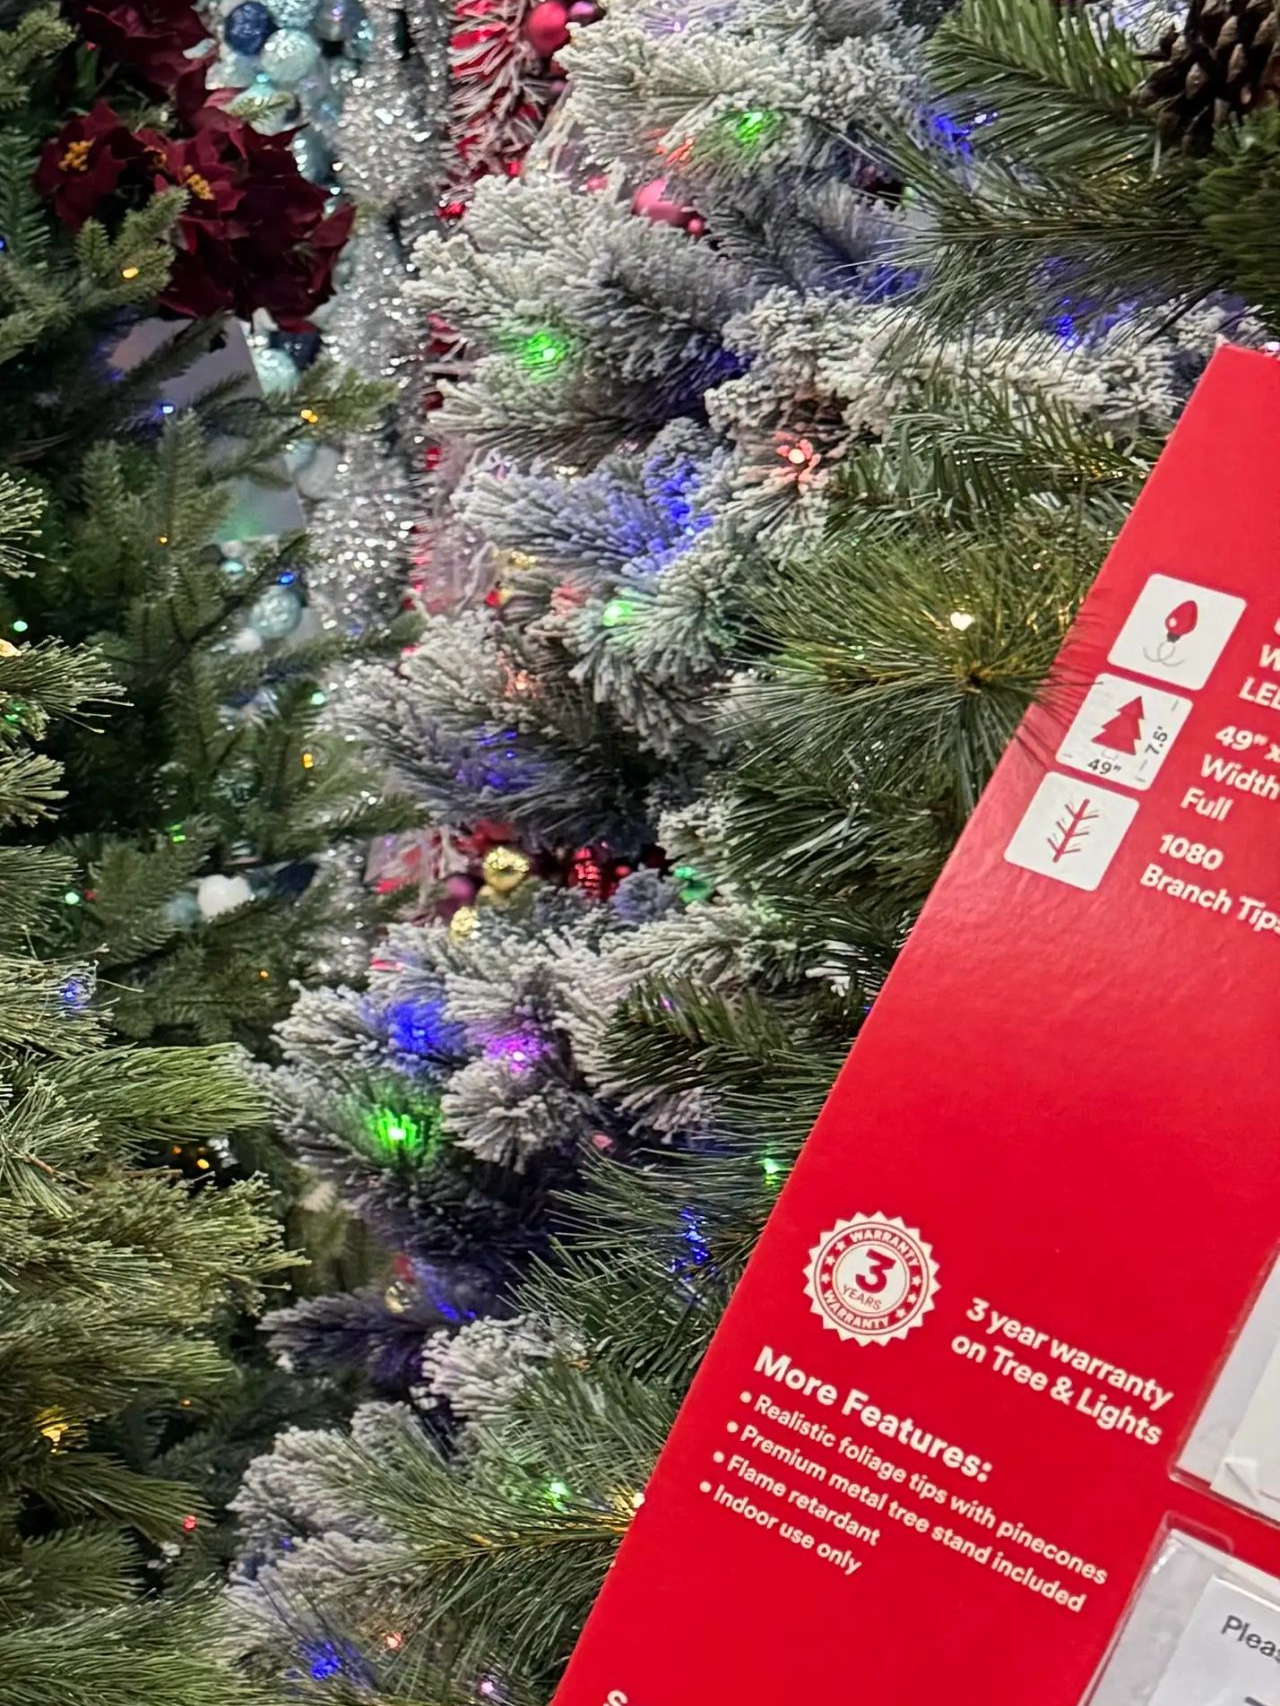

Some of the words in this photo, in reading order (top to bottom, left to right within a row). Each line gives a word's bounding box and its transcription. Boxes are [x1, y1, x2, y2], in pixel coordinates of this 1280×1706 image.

[1143, 724, 1168, 755] 7.5'
[1086, 758, 1122, 775] 49"
[1200, 753, 1280, 800] Width
[1179, 786, 1233, 821] Full
[1158, 833, 1224, 871] 1080
[1139, 862, 1232, 914] Branch
[850, 1228, 920, 1269] WARRANTY
[855, 1249, 897, 1294] 3
[823, 1290, 889, 1330] WARRANTY
[842, 1284, 883, 1311] YEARS
[965, 1297, 990, 1322] 3
[985, 1310, 1050, 1350] year
[1049, 1338, 1174, 1411] warranty
[950, 1334, 987, 1363] on
[991, 1344, 1049, 1391] Tree
[1049, 1375, 1074, 1405] &
[1075, 1386, 1162, 1445] Lights
[753, 1345, 838, 1406] More
[840, 1388, 992, 1483] Features:
[726, 1453, 787, 1497] Flame
[787, 1489, 881, 1546] retardant
[753, 1393, 836, 1448] Realistic
[837, 1435, 907, 1483] foliage
[907, 1472, 948, 1505] tips
[949, 1495, 996, 1529] with
[995, 1520, 1108, 1585] pinecones
[712, 1483, 779, 1529] Indoor
[778, 1522, 815, 1550] use
[815, 1542, 862, 1575] only
[739, 1423, 827, 1482] Premium
[827, 1472, 889, 1511] metal
[887, 1500, 930, 1533] tree
[930, 1525, 993, 1565] stand
[990, 1550, 1087, 1613] included
